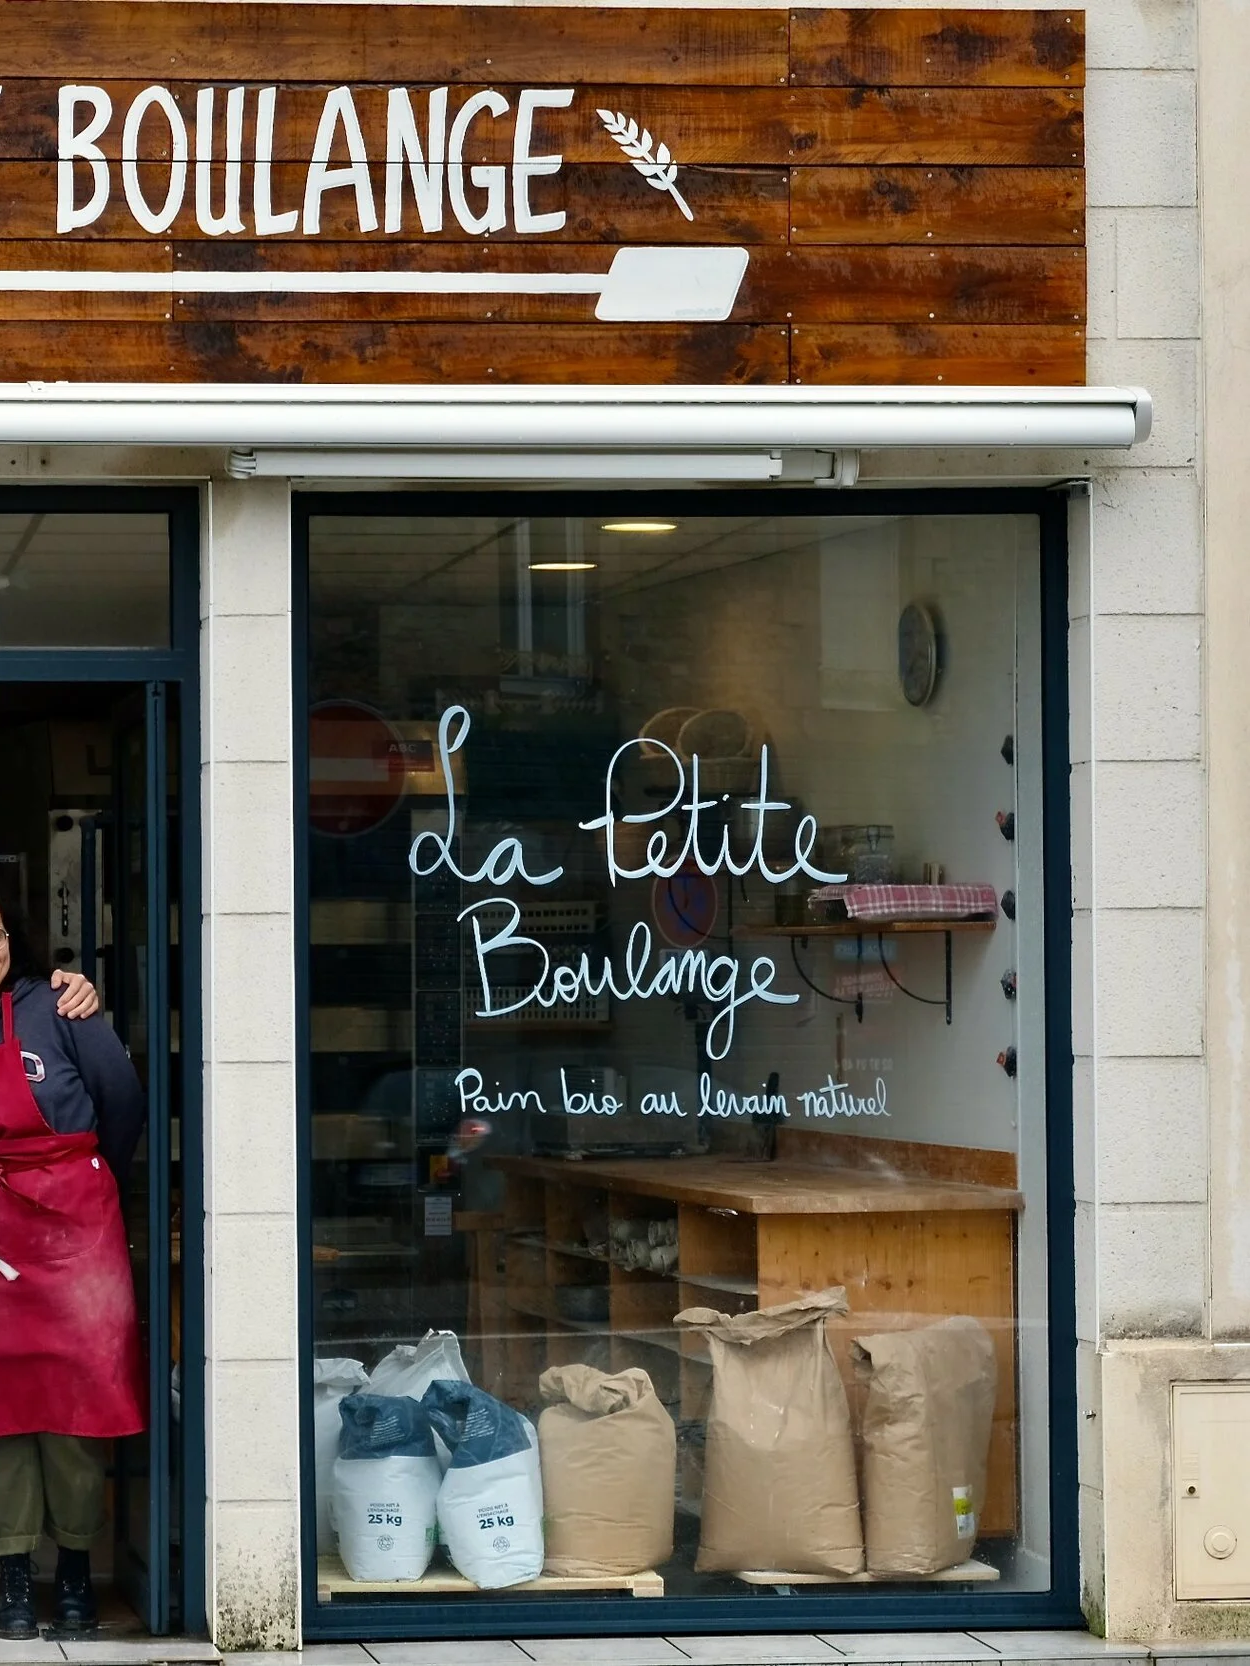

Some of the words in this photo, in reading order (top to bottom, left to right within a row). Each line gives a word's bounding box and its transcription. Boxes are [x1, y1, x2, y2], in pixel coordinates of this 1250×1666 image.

[56, 84, 575, 236] BOULANGE
[409, 705, 563, 885] La
[579, 737, 849, 888] Petite
[457, 898, 800, 1060] Boulange
[455, 1068, 547, 1114] Pain
[561, 1067, 624, 1115] bio
[640, 1093, 688, 1117] au
[697, 1072, 791, 1118] levain
[797, 1073, 892, 1117] naturel
[368, 1514, 383, 1524] 25
[386, 1514, 402, 1526] kg
[479, 1518, 495, 1530] 25
[497, 1516, 514, 1527] kg
